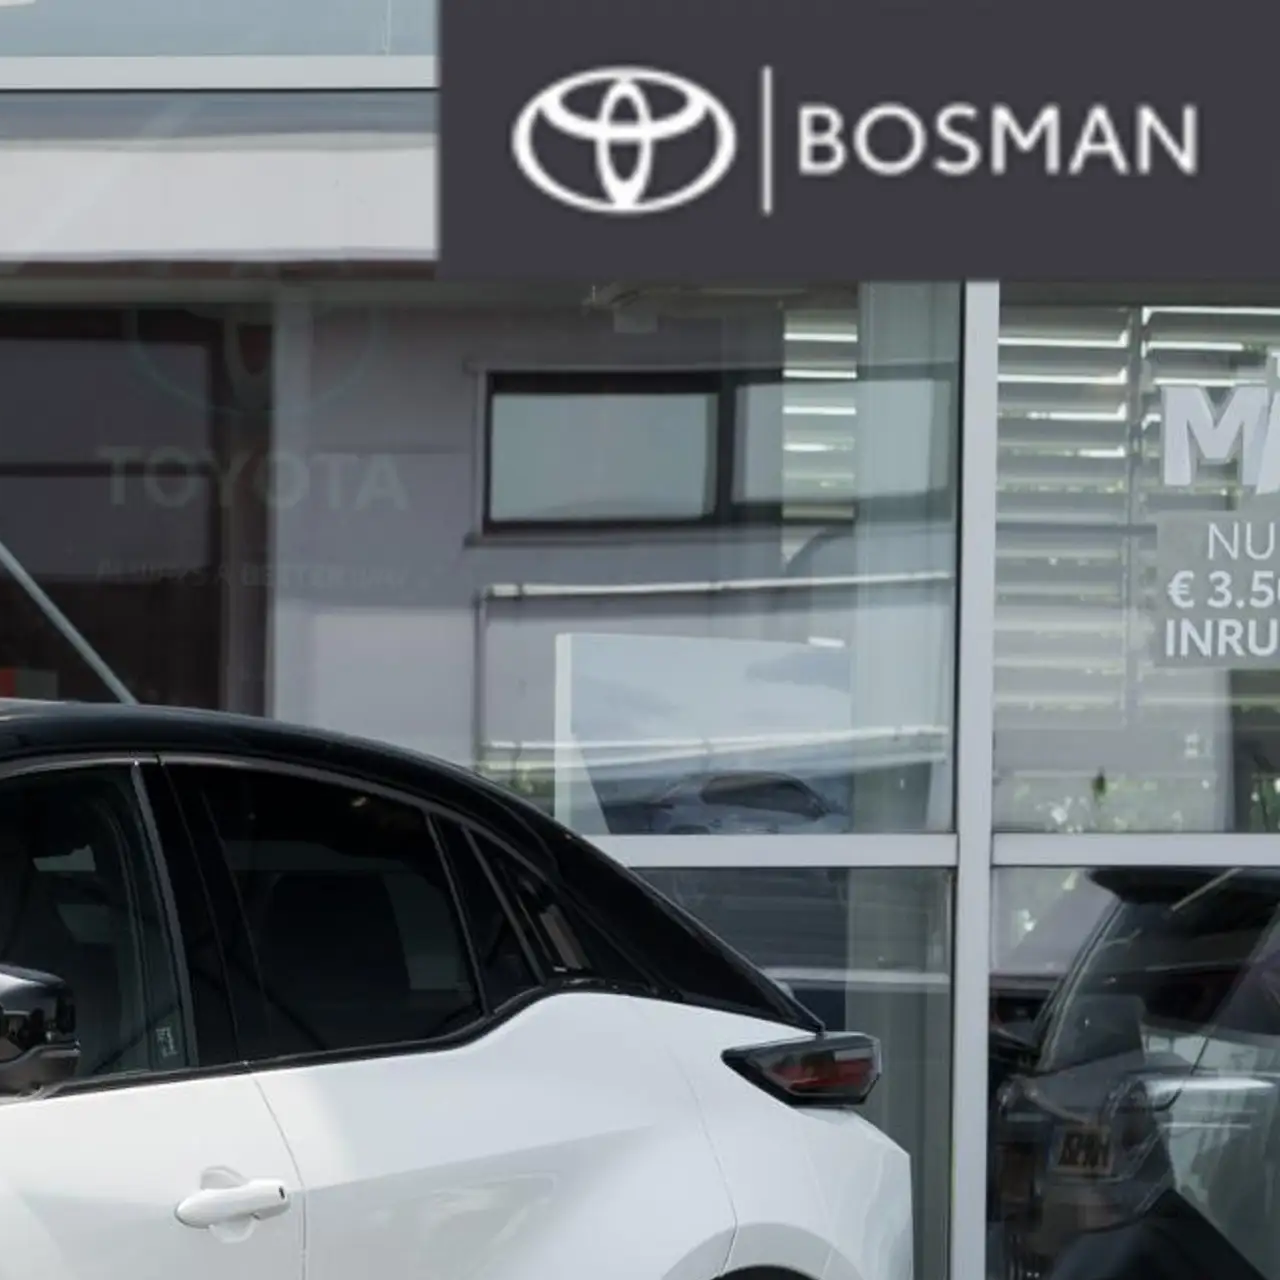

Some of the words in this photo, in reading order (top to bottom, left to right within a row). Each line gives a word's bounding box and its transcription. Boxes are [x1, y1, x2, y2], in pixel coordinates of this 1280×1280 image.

[96, 445, 410, 511] TOYOTA
[1208, 522, 1276, 561] NU
[1207, 570, 1280, 608] 3.5
